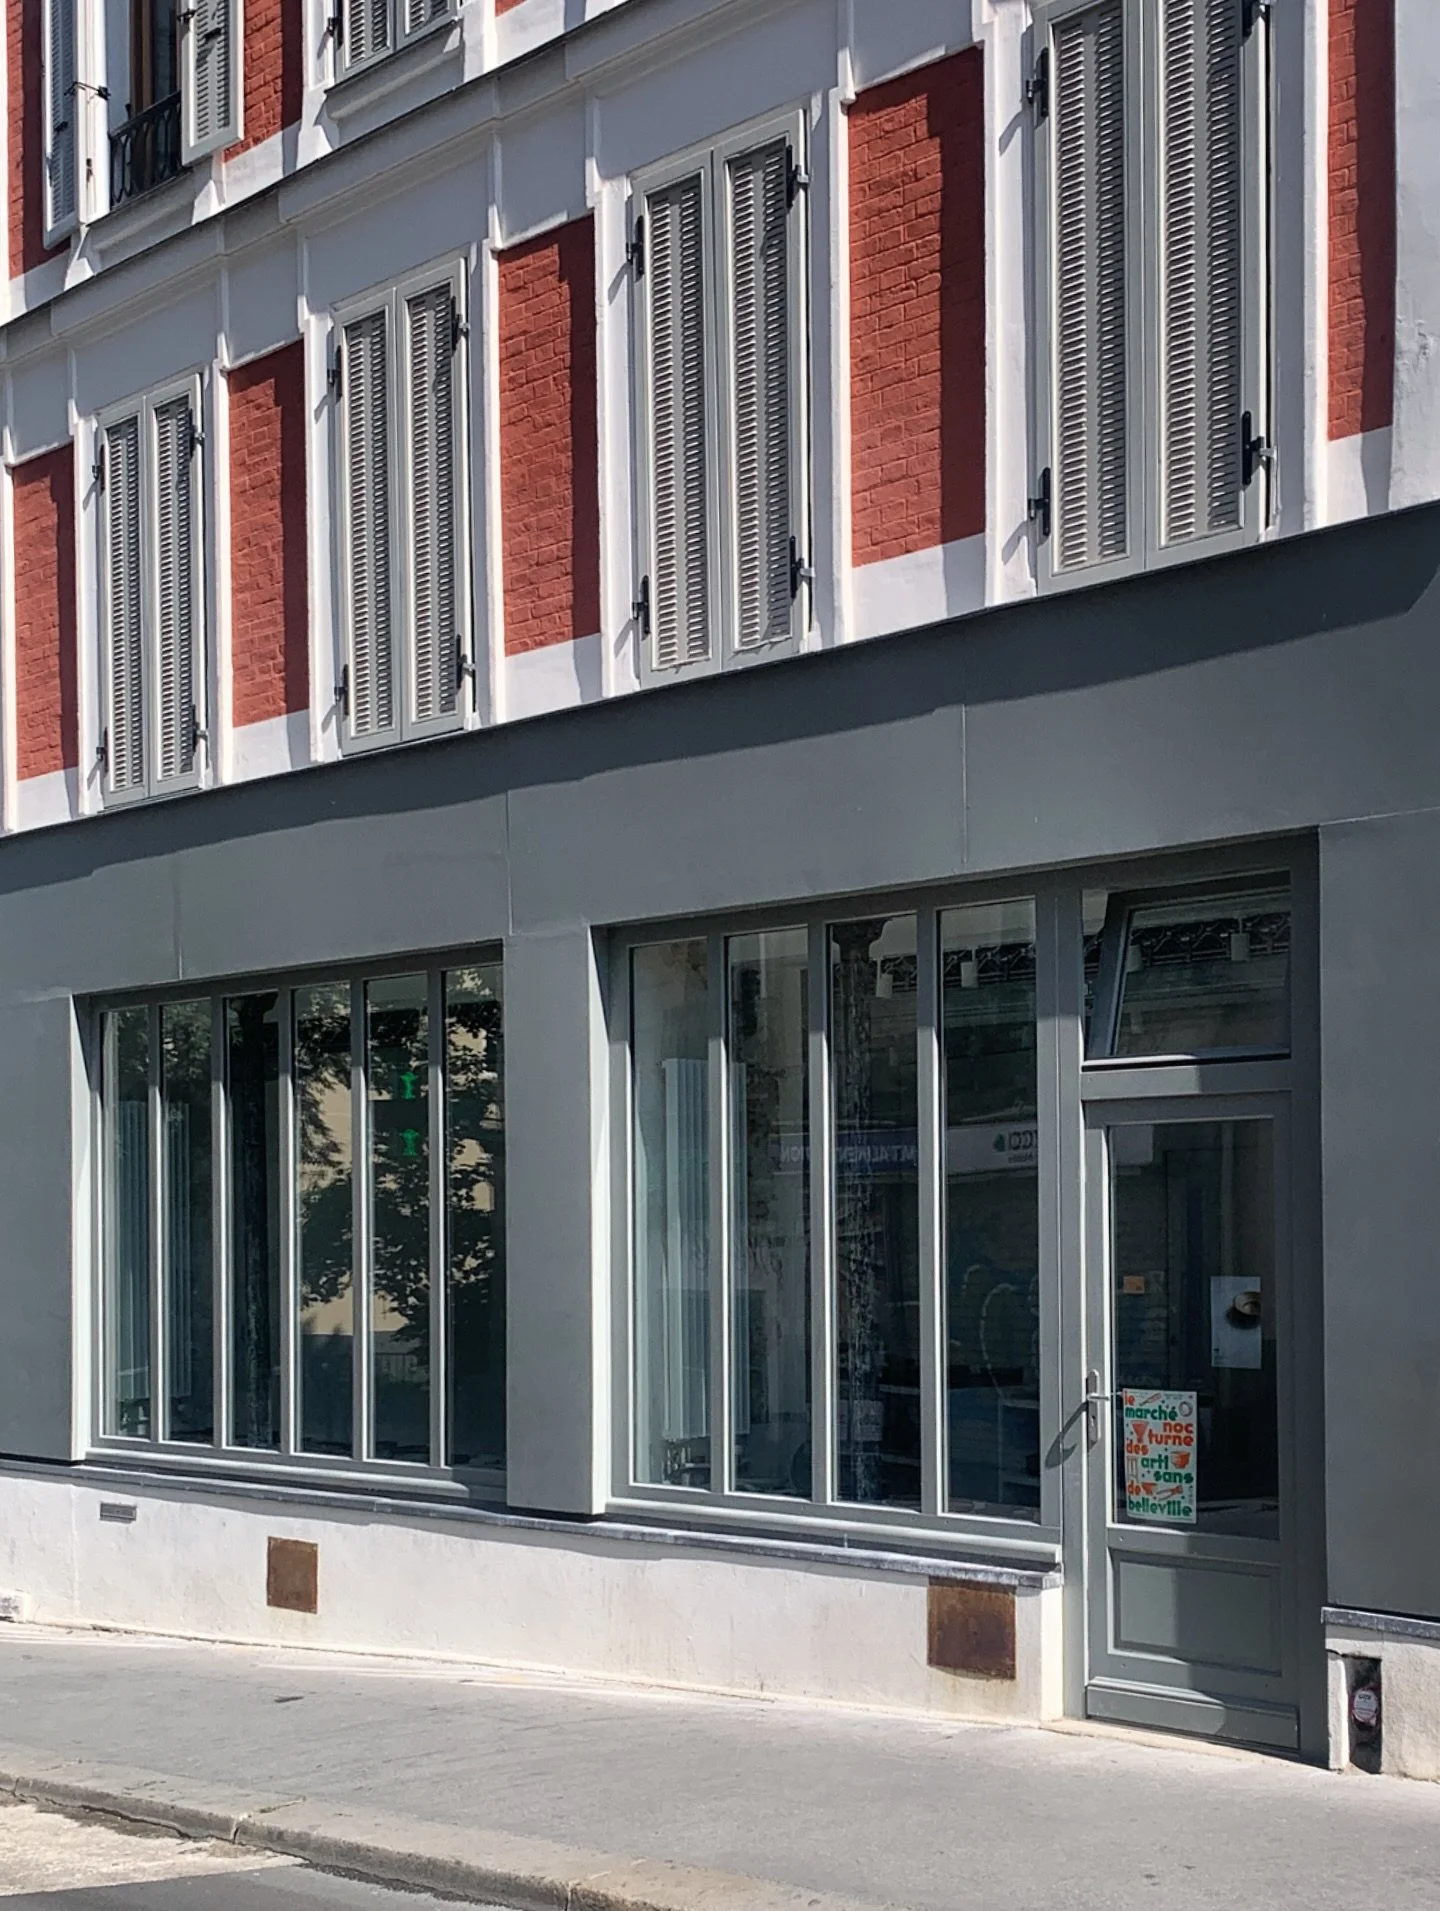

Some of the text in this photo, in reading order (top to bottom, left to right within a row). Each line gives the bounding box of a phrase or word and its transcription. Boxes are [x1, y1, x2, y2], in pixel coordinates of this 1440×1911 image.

[1124, 1390, 1136, 1406] le
[1125, 1405, 1178, 1421] marché
[1163, 1422, 1194, 1434] noc
[1148, 1428, 1194, 1447] turne
[1126, 1439, 1149, 1455] des
[1141, 1454, 1169, 1470] arti
[1154, 1471, 1194, 1484] sans
[1128, 1482, 1141, 1496] de
[1128, 1496, 1193, 1517] belleville
